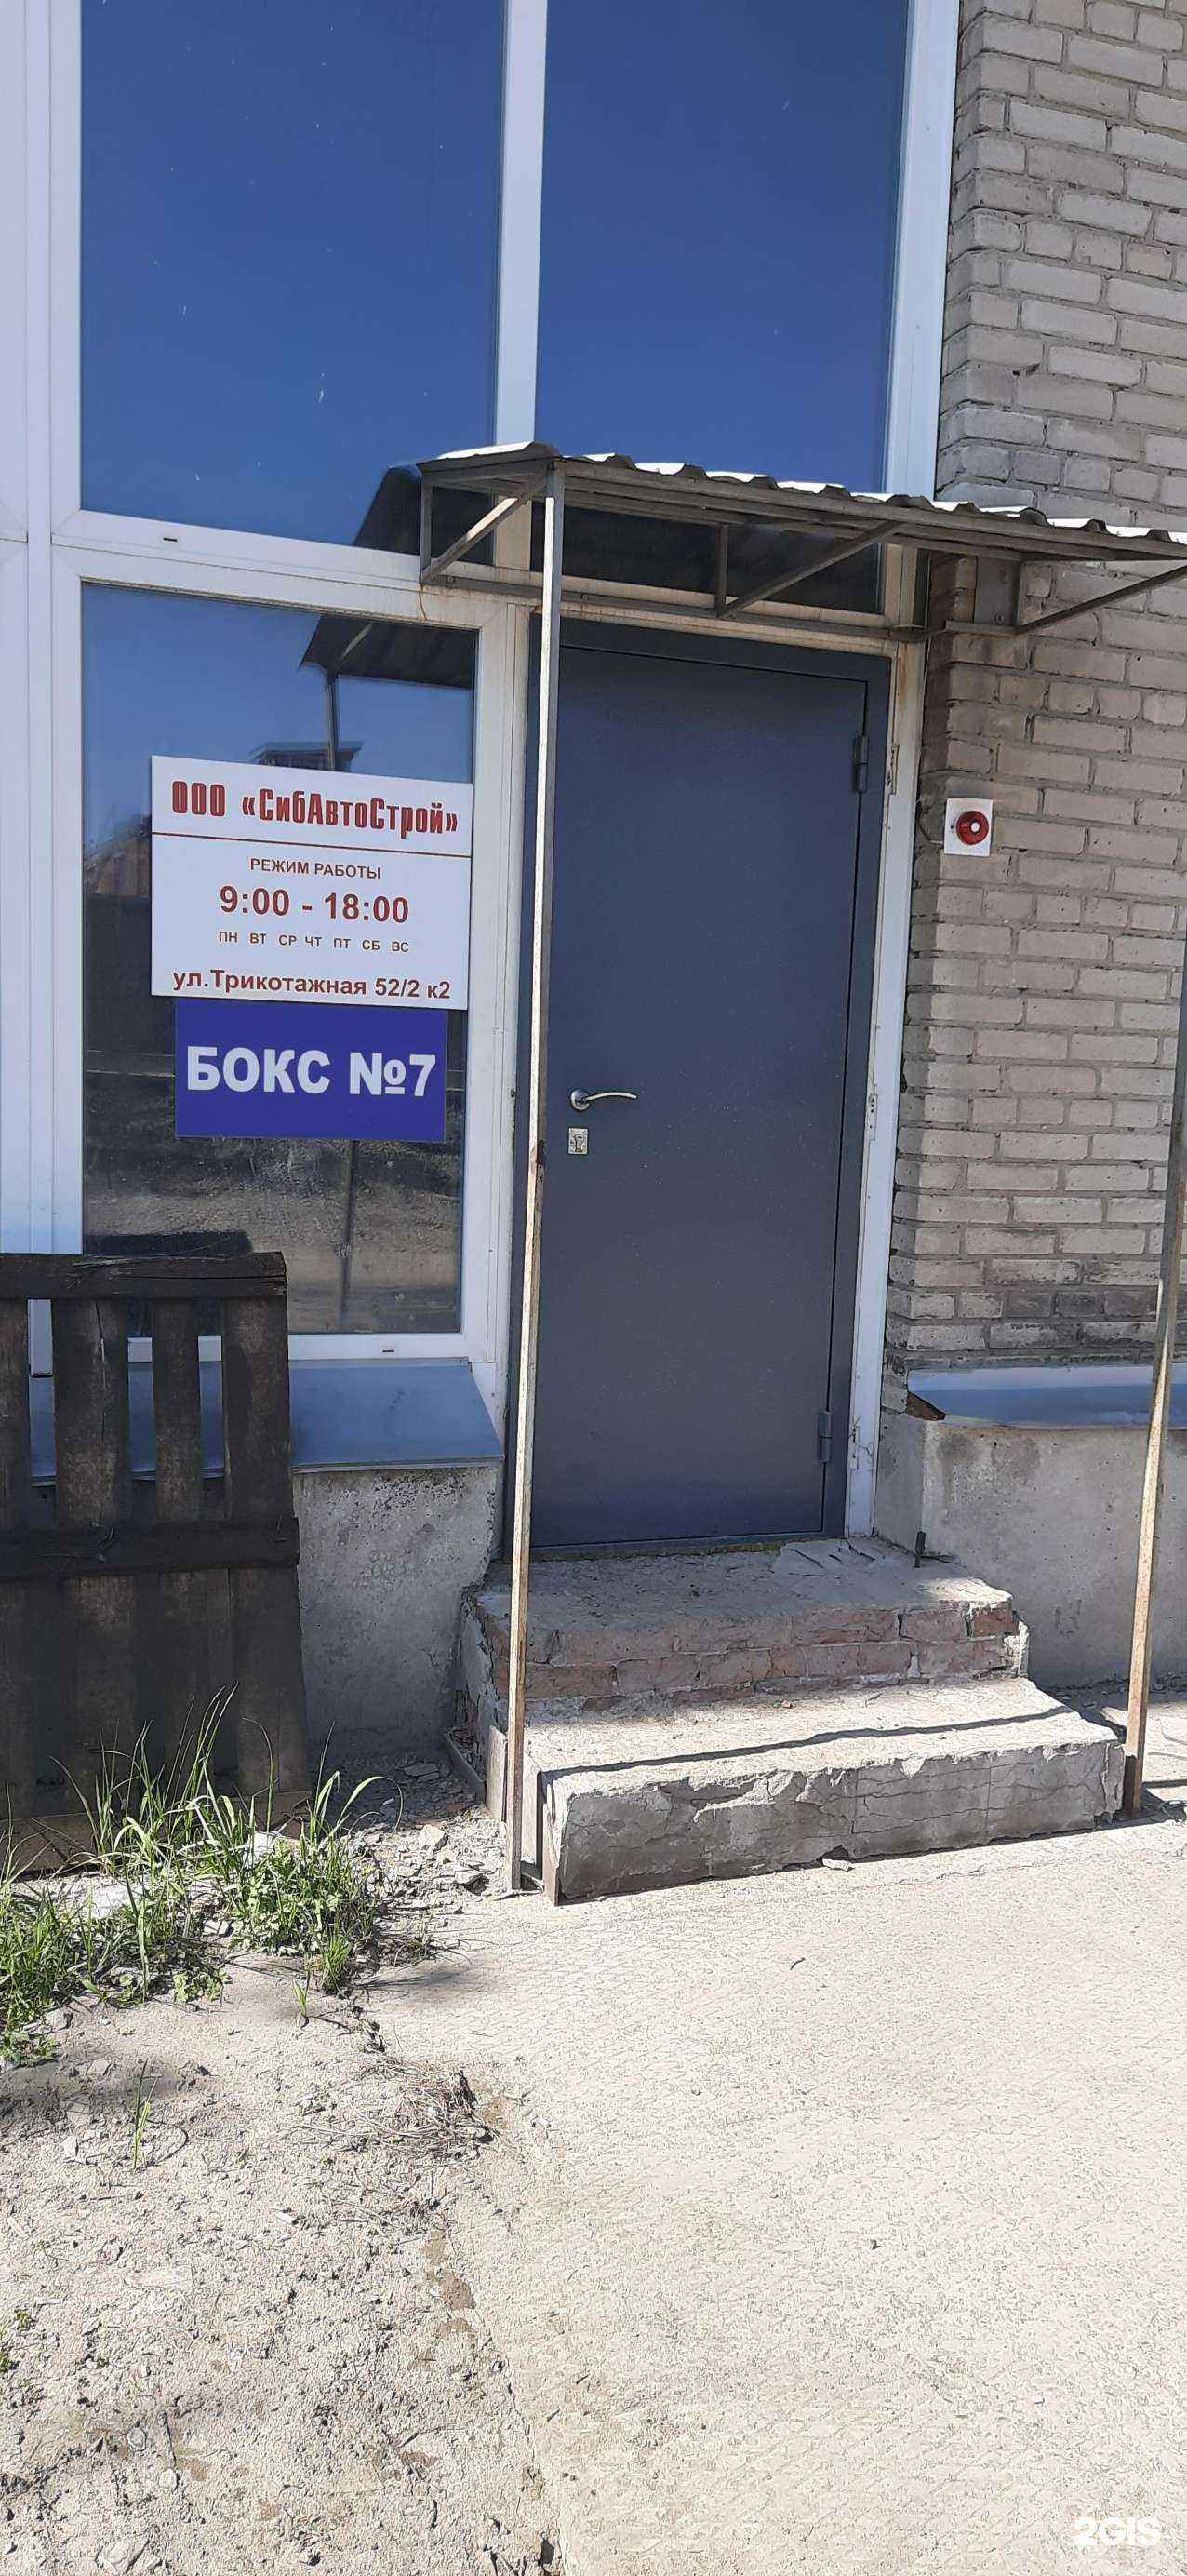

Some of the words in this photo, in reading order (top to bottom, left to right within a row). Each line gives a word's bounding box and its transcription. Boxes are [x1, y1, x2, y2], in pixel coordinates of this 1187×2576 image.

[172, 781, 226, 816] ООО
[242, 788, 457, 838] «СибАвтоСтрой»
[250, 858, 310, 874] РЕЖИМ
[314, 862, 380, 879] РАБОТЫ
[220, 886, 289, 916] 9:00
[325, 892, 408, 923] 18:00
[219, 932, 238, 943] ПН
[250, 932, 267, 945] ВТ
[279, 933, 297, 946] СР
[305, 935, 322, 947] ЧТ
[334, 937, 351, 949] ПТ
[362, 939, 380, 950] СБ
[392, 941, 409, 952] ВС
[173, 970, 367, 995] ул.Трикотажная
[375, 979, 420, 998] 52/2
[427, 981, 450, 999] к2
[187, 1046, 331, 1093] БОКС
[350, 1052, 436, 1097] №7
